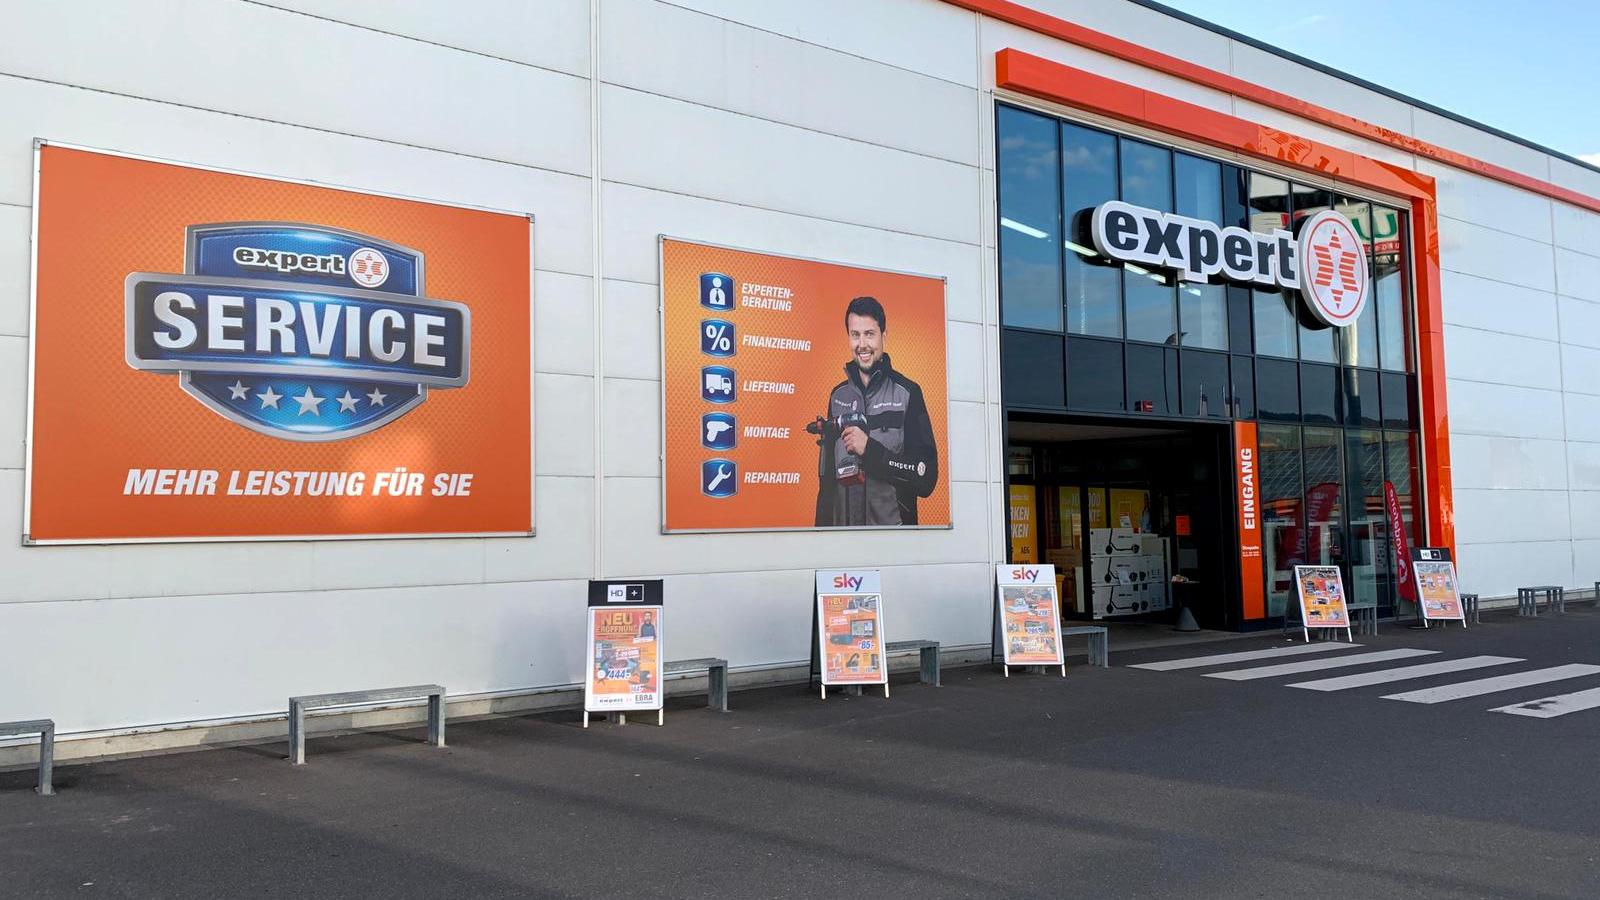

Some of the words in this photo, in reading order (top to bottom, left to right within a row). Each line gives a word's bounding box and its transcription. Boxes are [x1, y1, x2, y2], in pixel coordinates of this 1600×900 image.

[1103, 208, 1297, 281] expert
[234, 247, 345, 275] expert
[741, 283, 794, 299] EXPERTEN-
[742, 296, 792, 312] BERATUNG
[152, 291, 447, 367] SERVICE
[742, 335, 811, 352] FINANZIERUNG
[743, 380, 795, 395] LIEFERUNG
[744, 426, 790, 439] MONTAGE
[888, 460, 915, 472] expert
[123, 468, 219, 496] MEHR
[227, 470, 366, 497] LEISTUNG
[372, 467, 424, 497] FÜR
[431, 473, 474, 497] SIE
[744, 471, 801, 485] REPARATUR
[1240, 447, 1256, 530] EINGANG
[833, 573, 863, 591] sky
[1012, 566, 1039, 583] sky
[610, 589, 624, 597] HD
